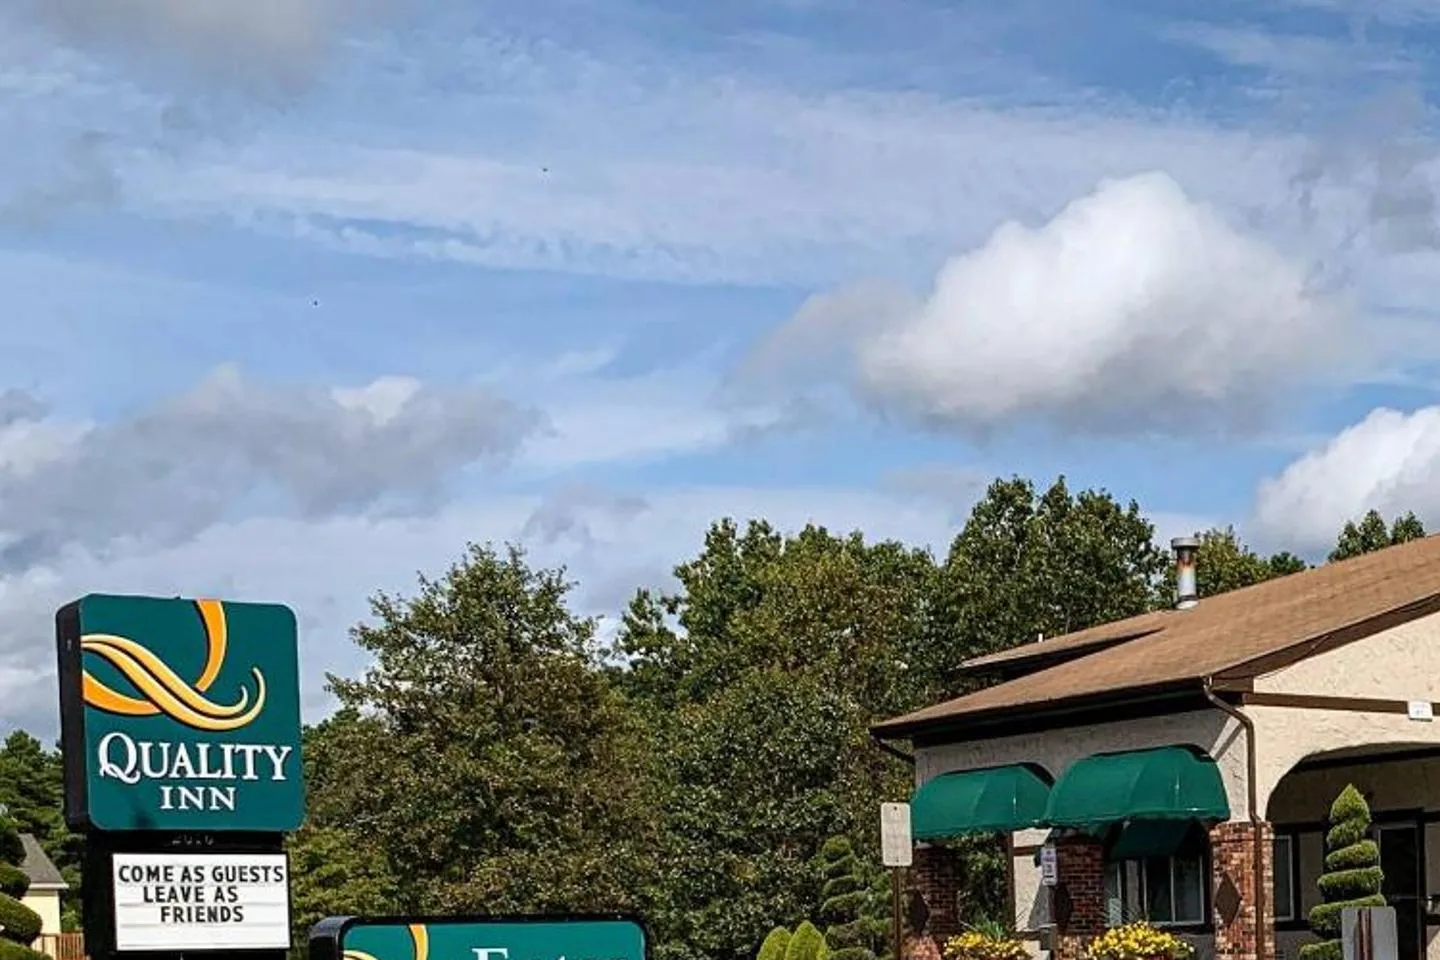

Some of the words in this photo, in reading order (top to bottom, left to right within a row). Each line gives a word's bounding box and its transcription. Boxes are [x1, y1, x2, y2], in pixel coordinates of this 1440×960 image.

[98, 732, 292, 784] QUALITY
[160, 786, 236, 810] INN
[118, 865, 174, 883] COME
[180, 865, 205, 883] AS
[211, 865, 284, 883] GUESTS
[143, 886, 205, 903] LEAVE
[214, 886, 239, 903] AS
[160, 906, 244, 923] FRIENDS
